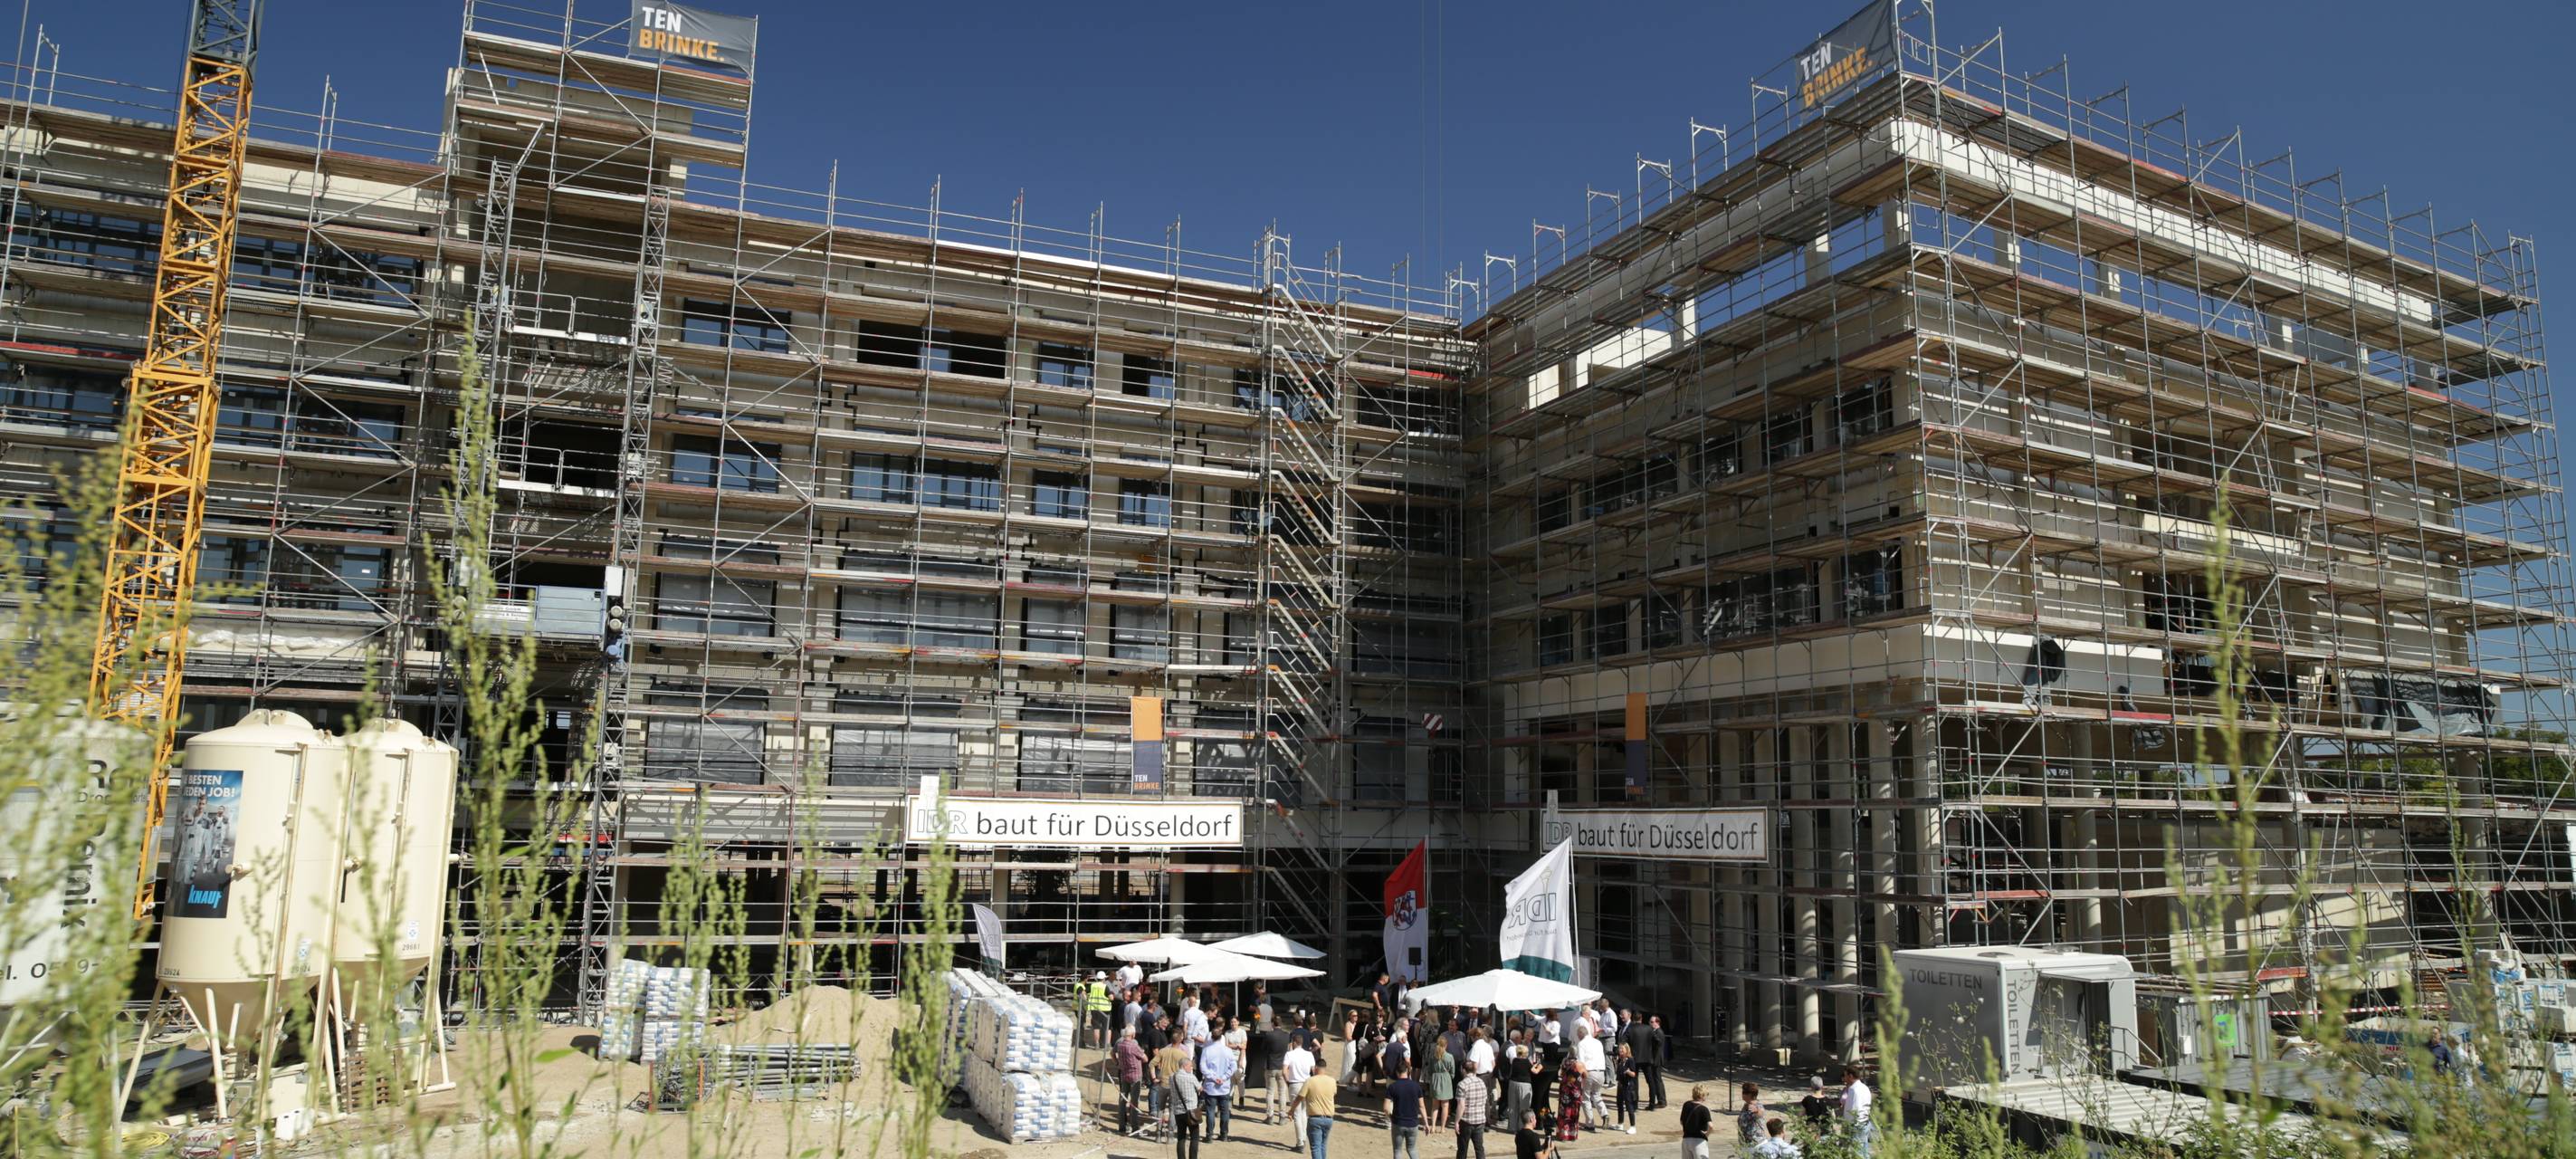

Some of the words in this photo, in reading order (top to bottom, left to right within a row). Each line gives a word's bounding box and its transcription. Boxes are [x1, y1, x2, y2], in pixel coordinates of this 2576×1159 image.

[642, 6, 682, 33] TEN
[639, 28, 724, 62] BRINKE.
[1800, 42, 1831, 81] TEN
[187, 774, 222, 786] BESTEN
[1134, 774, 1148, 782] TEN
[1134, 781, 1159, 790] BRINKE
[207, 786, 235, 798] JOB!
[917, 809, 968, 834] IDR
[977, 811, 1037, 835] baut
[1047, 813, 1085, 836] für
[1095, 814, 1232, 838] Düsseldorf
[1578, 822, 1614, 847] baut
[1620, 822, 1644, 848] für
[1649, 822, 1758, 850] Düsseldorf
[1909, 969, 1983, 990] TOILETTEN
[2007, 980, 2020, 1075] TOILETTEN
